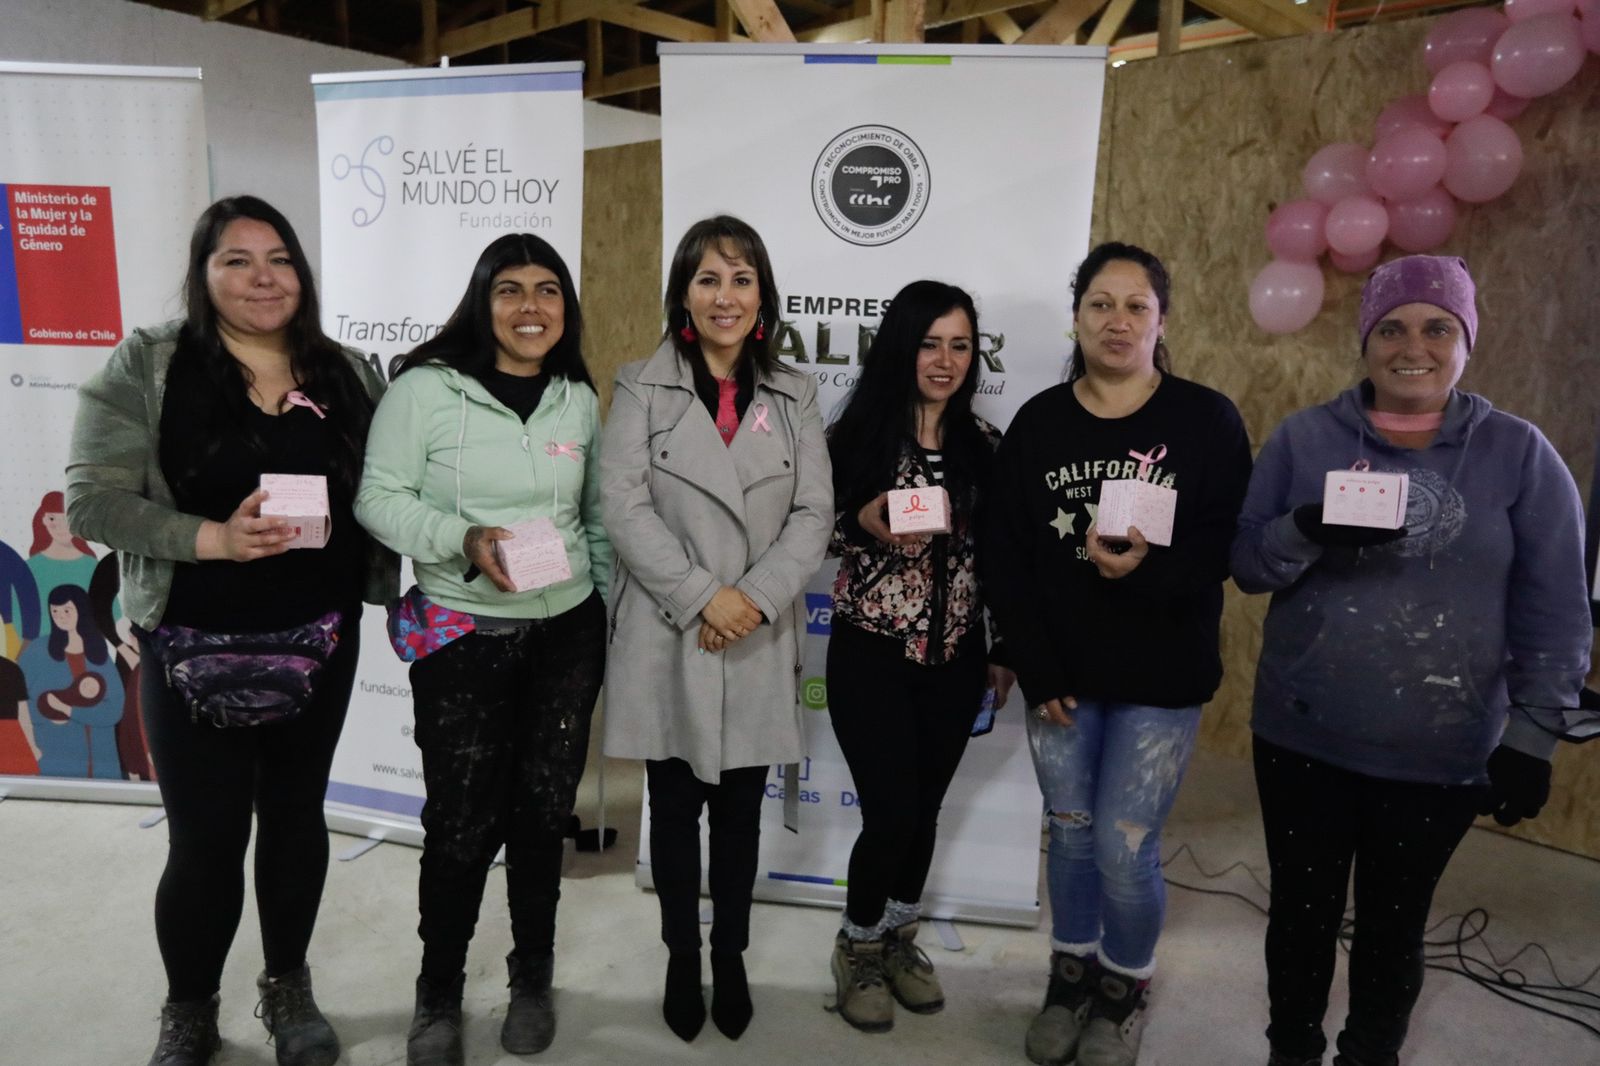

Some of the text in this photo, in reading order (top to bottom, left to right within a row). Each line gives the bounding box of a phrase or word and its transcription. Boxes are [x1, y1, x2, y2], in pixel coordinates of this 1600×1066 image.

[402, 143, 512, 175] SALVÉ EL
[824, 132, 920, 170] RECONOCIMIENTO DE OBRA
[841, 165, 902, 176] COMPROMISO
[883, 176, 902, 184] PRO
[14, 191, 97, 206] Ministerio de
[402, 178, 560, 205] MUNDO HOY
[16, 207, 93, 223] la Mujer y la
[819, 179, 923, 239] CONSTRUIMOS UN MEJOR FUTURO PARA TODOS
[459, 211, 552, 229] Fundación
[18, 223, 86, 237] Equidad de
[20, 239, 63, 251] Género
[786, 295, 894, 318] EMPRES
[29, 328, 116, 341] Gobierno de Chile
[833, 372, 857, 388] Co
[1065, 486, 1093, 500] WEST
[764, 783, 821, 804] Caas
